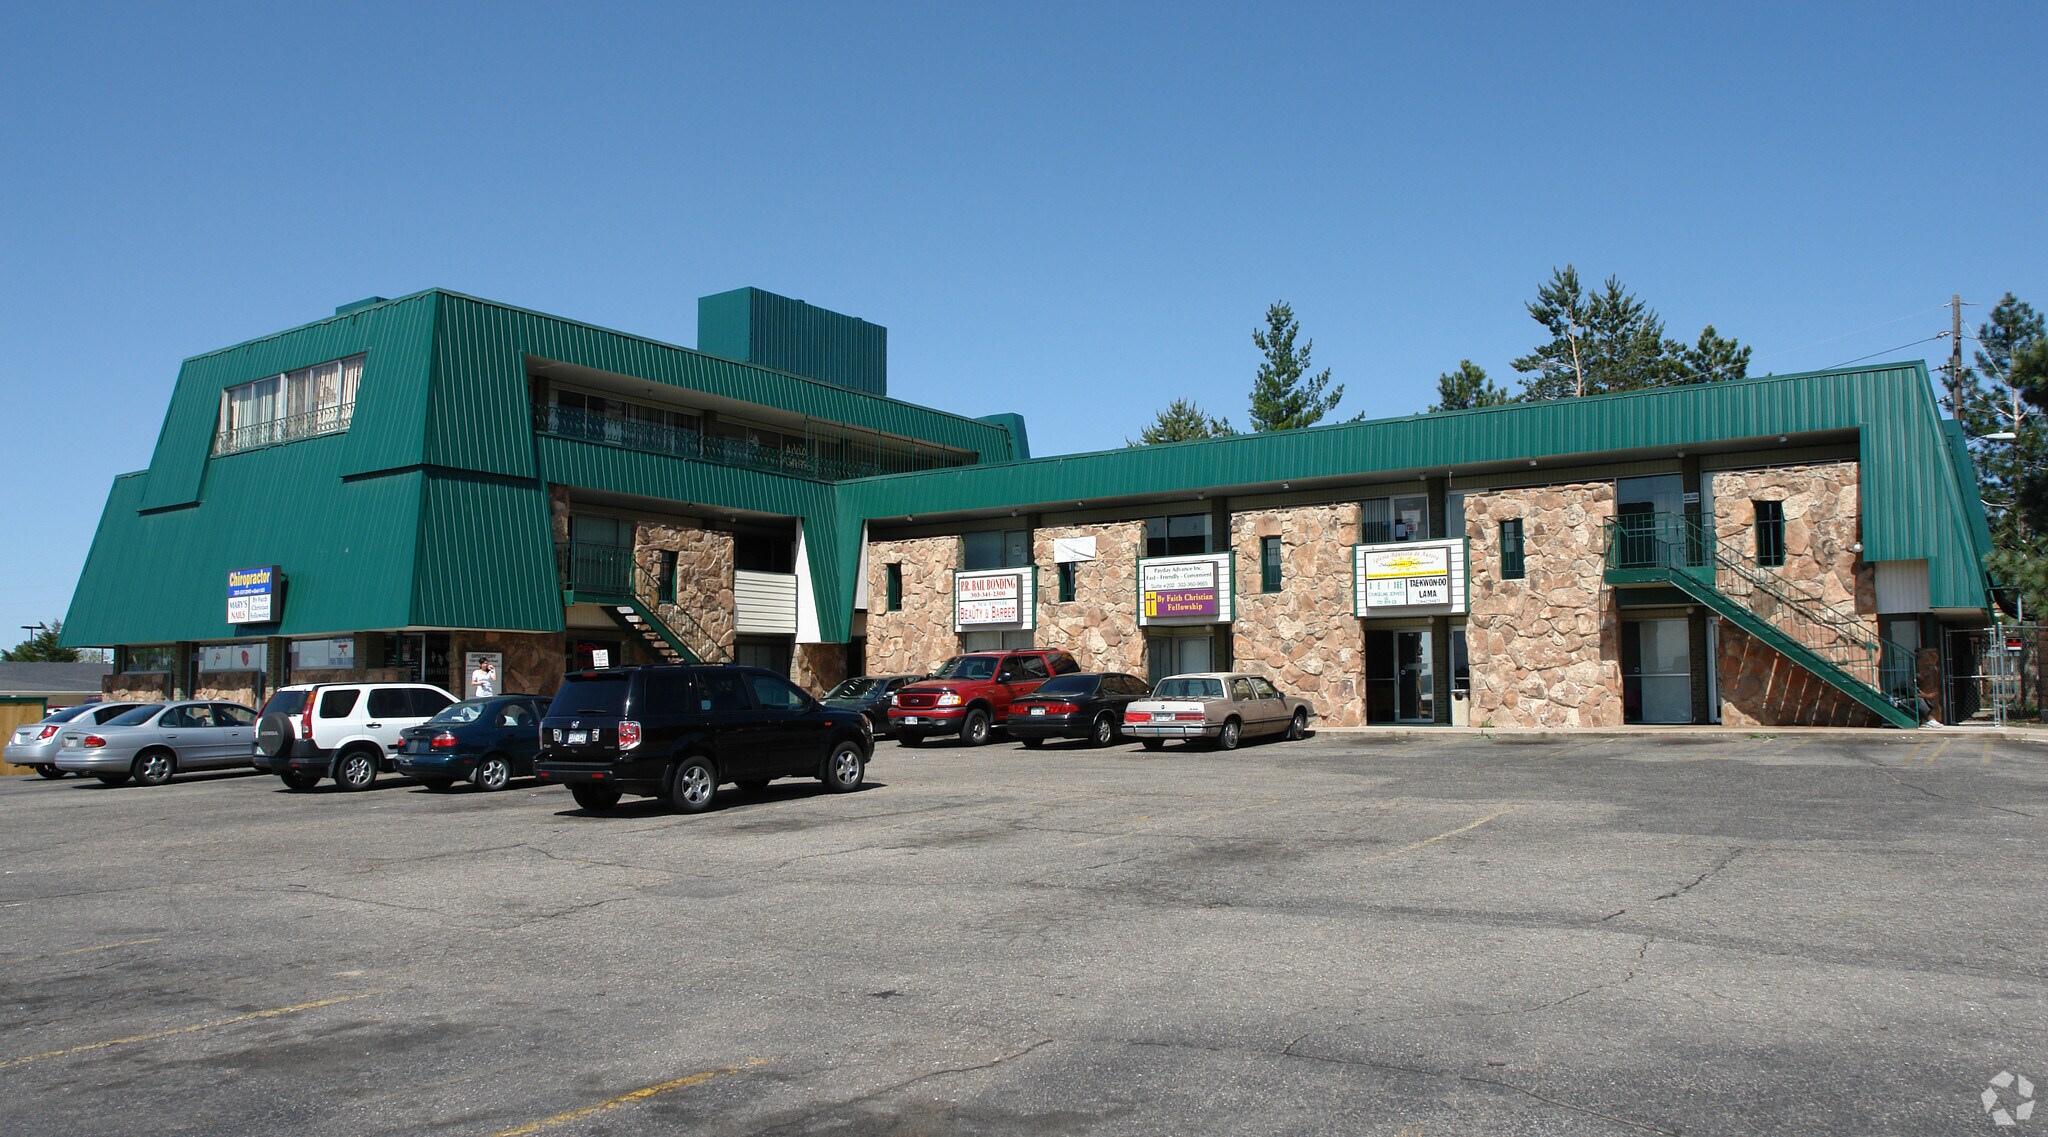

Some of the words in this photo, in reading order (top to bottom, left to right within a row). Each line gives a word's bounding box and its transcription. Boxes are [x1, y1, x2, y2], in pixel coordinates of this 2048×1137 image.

[230, 570, 270, 588] Chiropractor
[1410, 578, 1446, 587] TAE-KWON-DO
[972, 580, 985, 590] BAIL
[987, 578, 1016, 590] BONDING
[1419, 590, 1437, 598] LAMA
[230, 601, 247, 609] MARY'S
[1168, 603, 1203, 611] Fellowship
[232, 611, 246, 619] NAILS
[961, 608, 982, 620] BEAUTY
[992, 606, 1015, 618] BARBER
